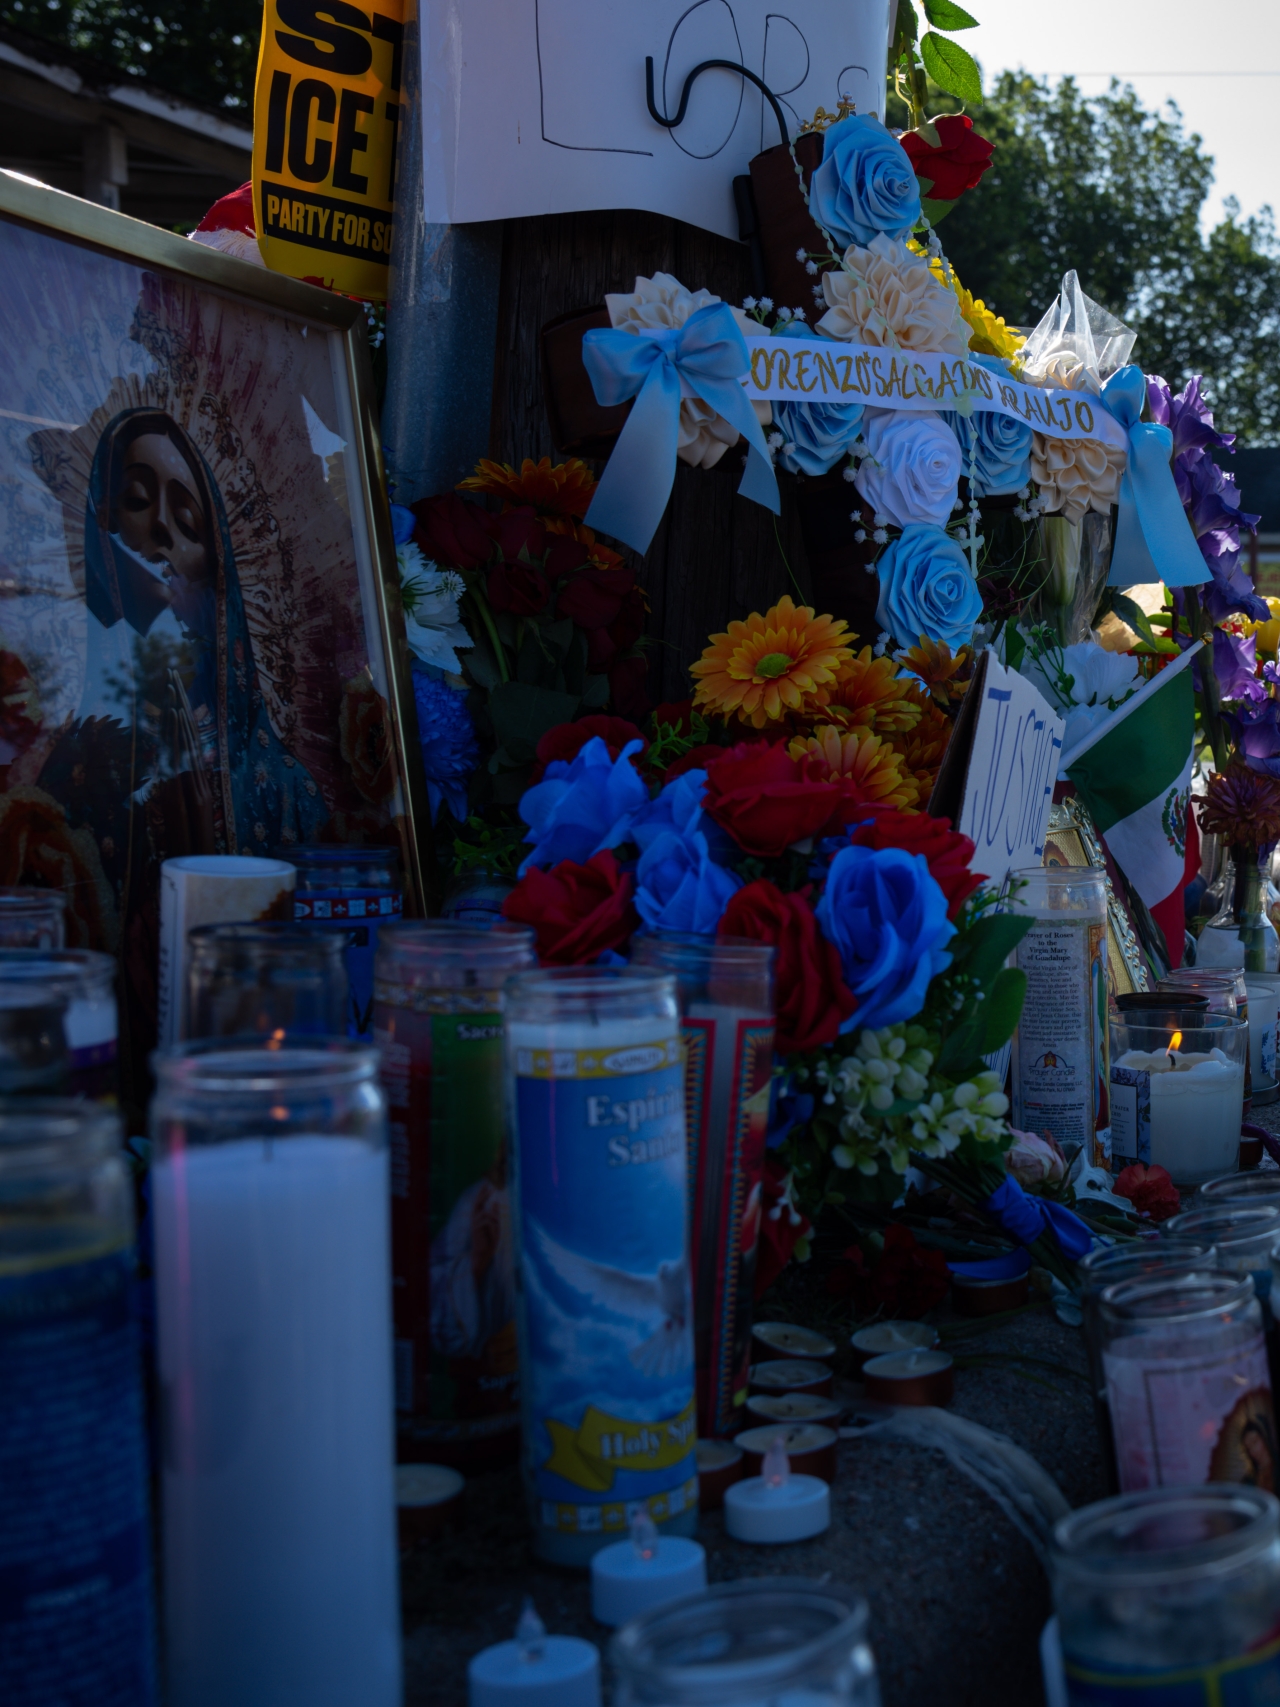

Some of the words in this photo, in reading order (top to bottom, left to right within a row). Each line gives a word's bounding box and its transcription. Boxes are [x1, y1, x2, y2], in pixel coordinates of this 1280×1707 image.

[265, 69, 374, 195] ICE
[267, 194, 330, 239] PARTY
[331, 210, 369, 248] FOR
[741, 347, 871, 397] ORENZO
[1050, 947, 1068, 955] Mary
[1028, 1068, 1048, 1077] Prayer
[1051, 1068, 1075, 1076] Candle
[599, 1427, 663, 1460] Holy
